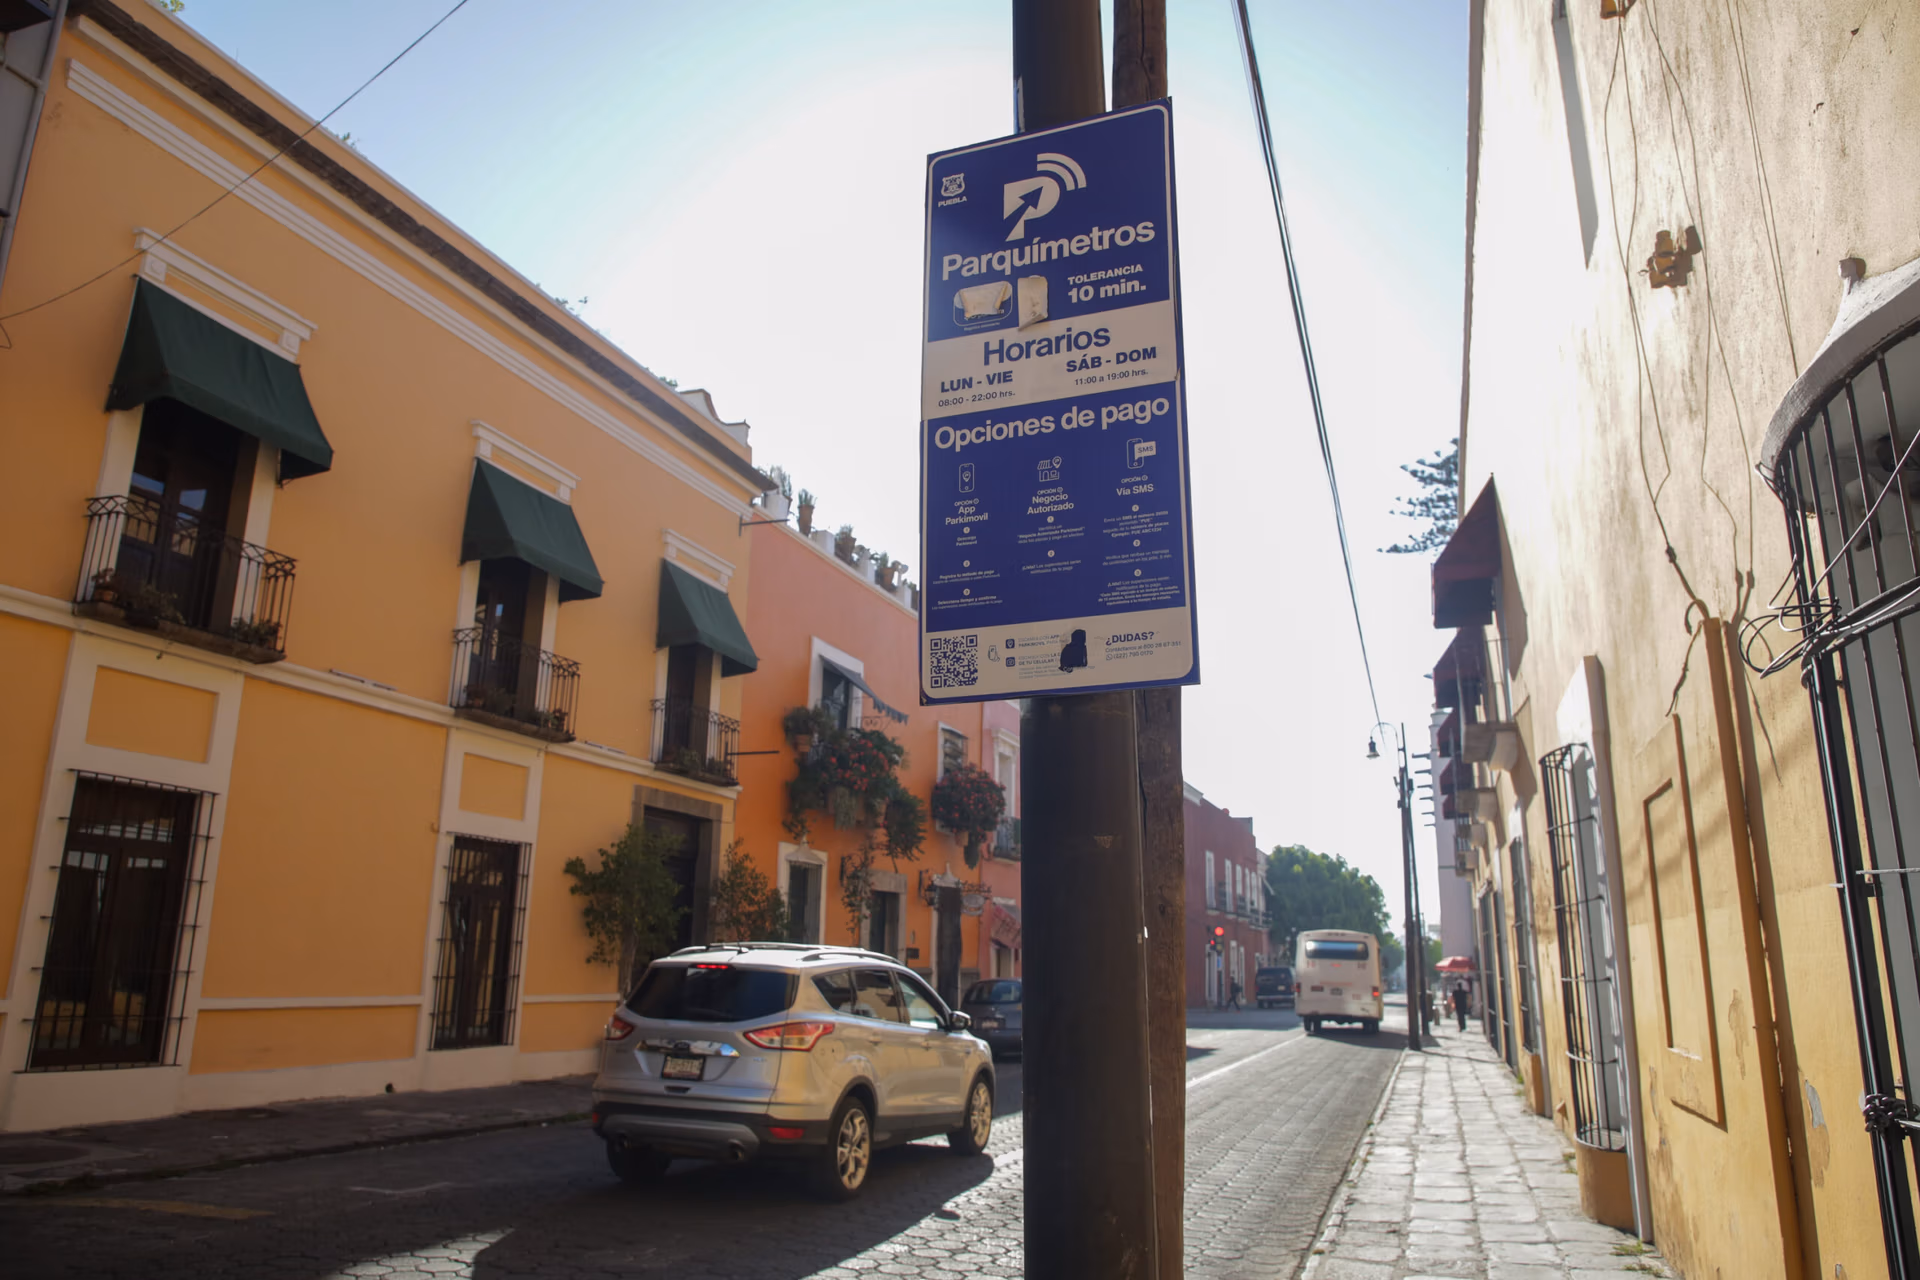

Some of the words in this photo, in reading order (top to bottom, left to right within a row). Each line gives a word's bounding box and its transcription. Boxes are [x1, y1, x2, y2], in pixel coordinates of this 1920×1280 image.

[938, 195, 968, 208] PUEBLA
[942, 221, 1156, 281] Parquímetros
[1067, 264, 1144, 286] TOLERANCIA
[1068, 285, 1094, 303] 10
[1099, 278, 1147, 299] min.
[983, 327, 1111, 366] Horarios
[1066, 354, 1102, 372] SÁB
[1115, 346, 1157, 365] DOM
[940, 376, 973, 393] LUN
[986, 370, 1013, 386] VIE
[1075, 375, 1097, 386] 11:00
[1106, 371, 1130, 381] 19:00
[1131, 368, 1149, 377] hrs.
[938, 397, 964, 408] 08:00
[971, 391, 998, 402] 22:00
[999, 389, 1016, 398] hrs.
[934, 415, 1056, 452] Opciones
[1061, 405, 1096, 430] de
[1101, 397, 1169, 430] pago
[1137, 445, 1154, 454] SMS
[1132, 483, 1154, 494] SMS
[1032, 493, 1069, 505] Negocio
[958, 506, 976, 514] App
[1027, 502, 1075, 515] Autorizado
[945, 512, 989, 525] Parkimovil
[1105, 631, 1154, 646] ¿DUDAS?
